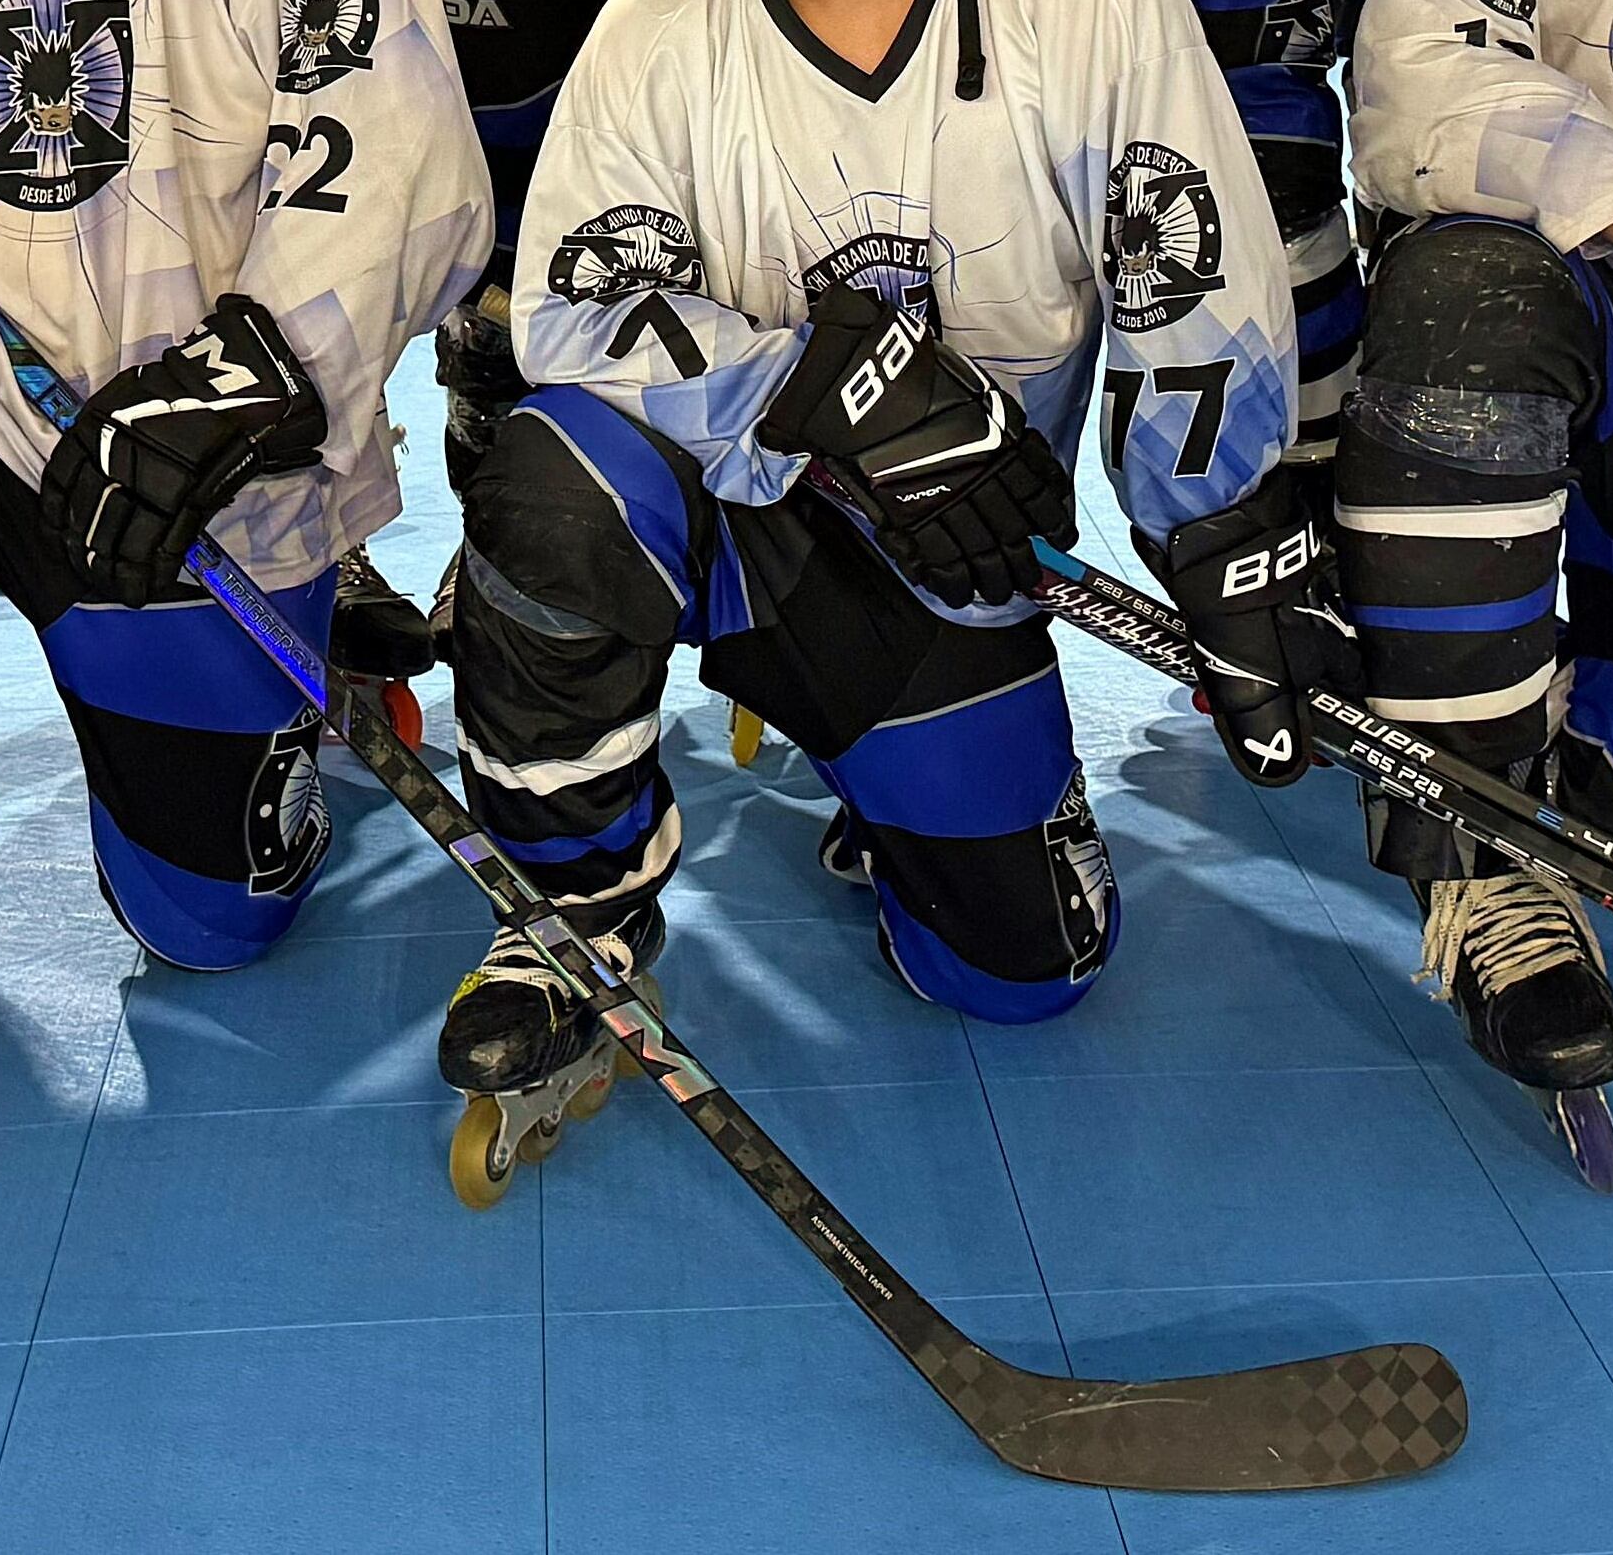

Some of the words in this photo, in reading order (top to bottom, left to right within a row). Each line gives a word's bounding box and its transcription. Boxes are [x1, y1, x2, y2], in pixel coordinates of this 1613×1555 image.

[1137, 146, 1152, 165] DE
[19, 185, 55, 203] DESDE
[645, 210, 664, 229] DE
[829, 238, 891, 280] ARANDA
[893, 240, 912, 265] DE
[1143, 306, 1167, 325] 2010
[1093, 578, 1124, 599] P28
[1349, 740, 1396, 773] F65
[1398, 765, 1444, 799] P28
[810, 1215, 869, 1278] ASYMMETRICAL
[867, 1274, 894, 1301] TAPER
